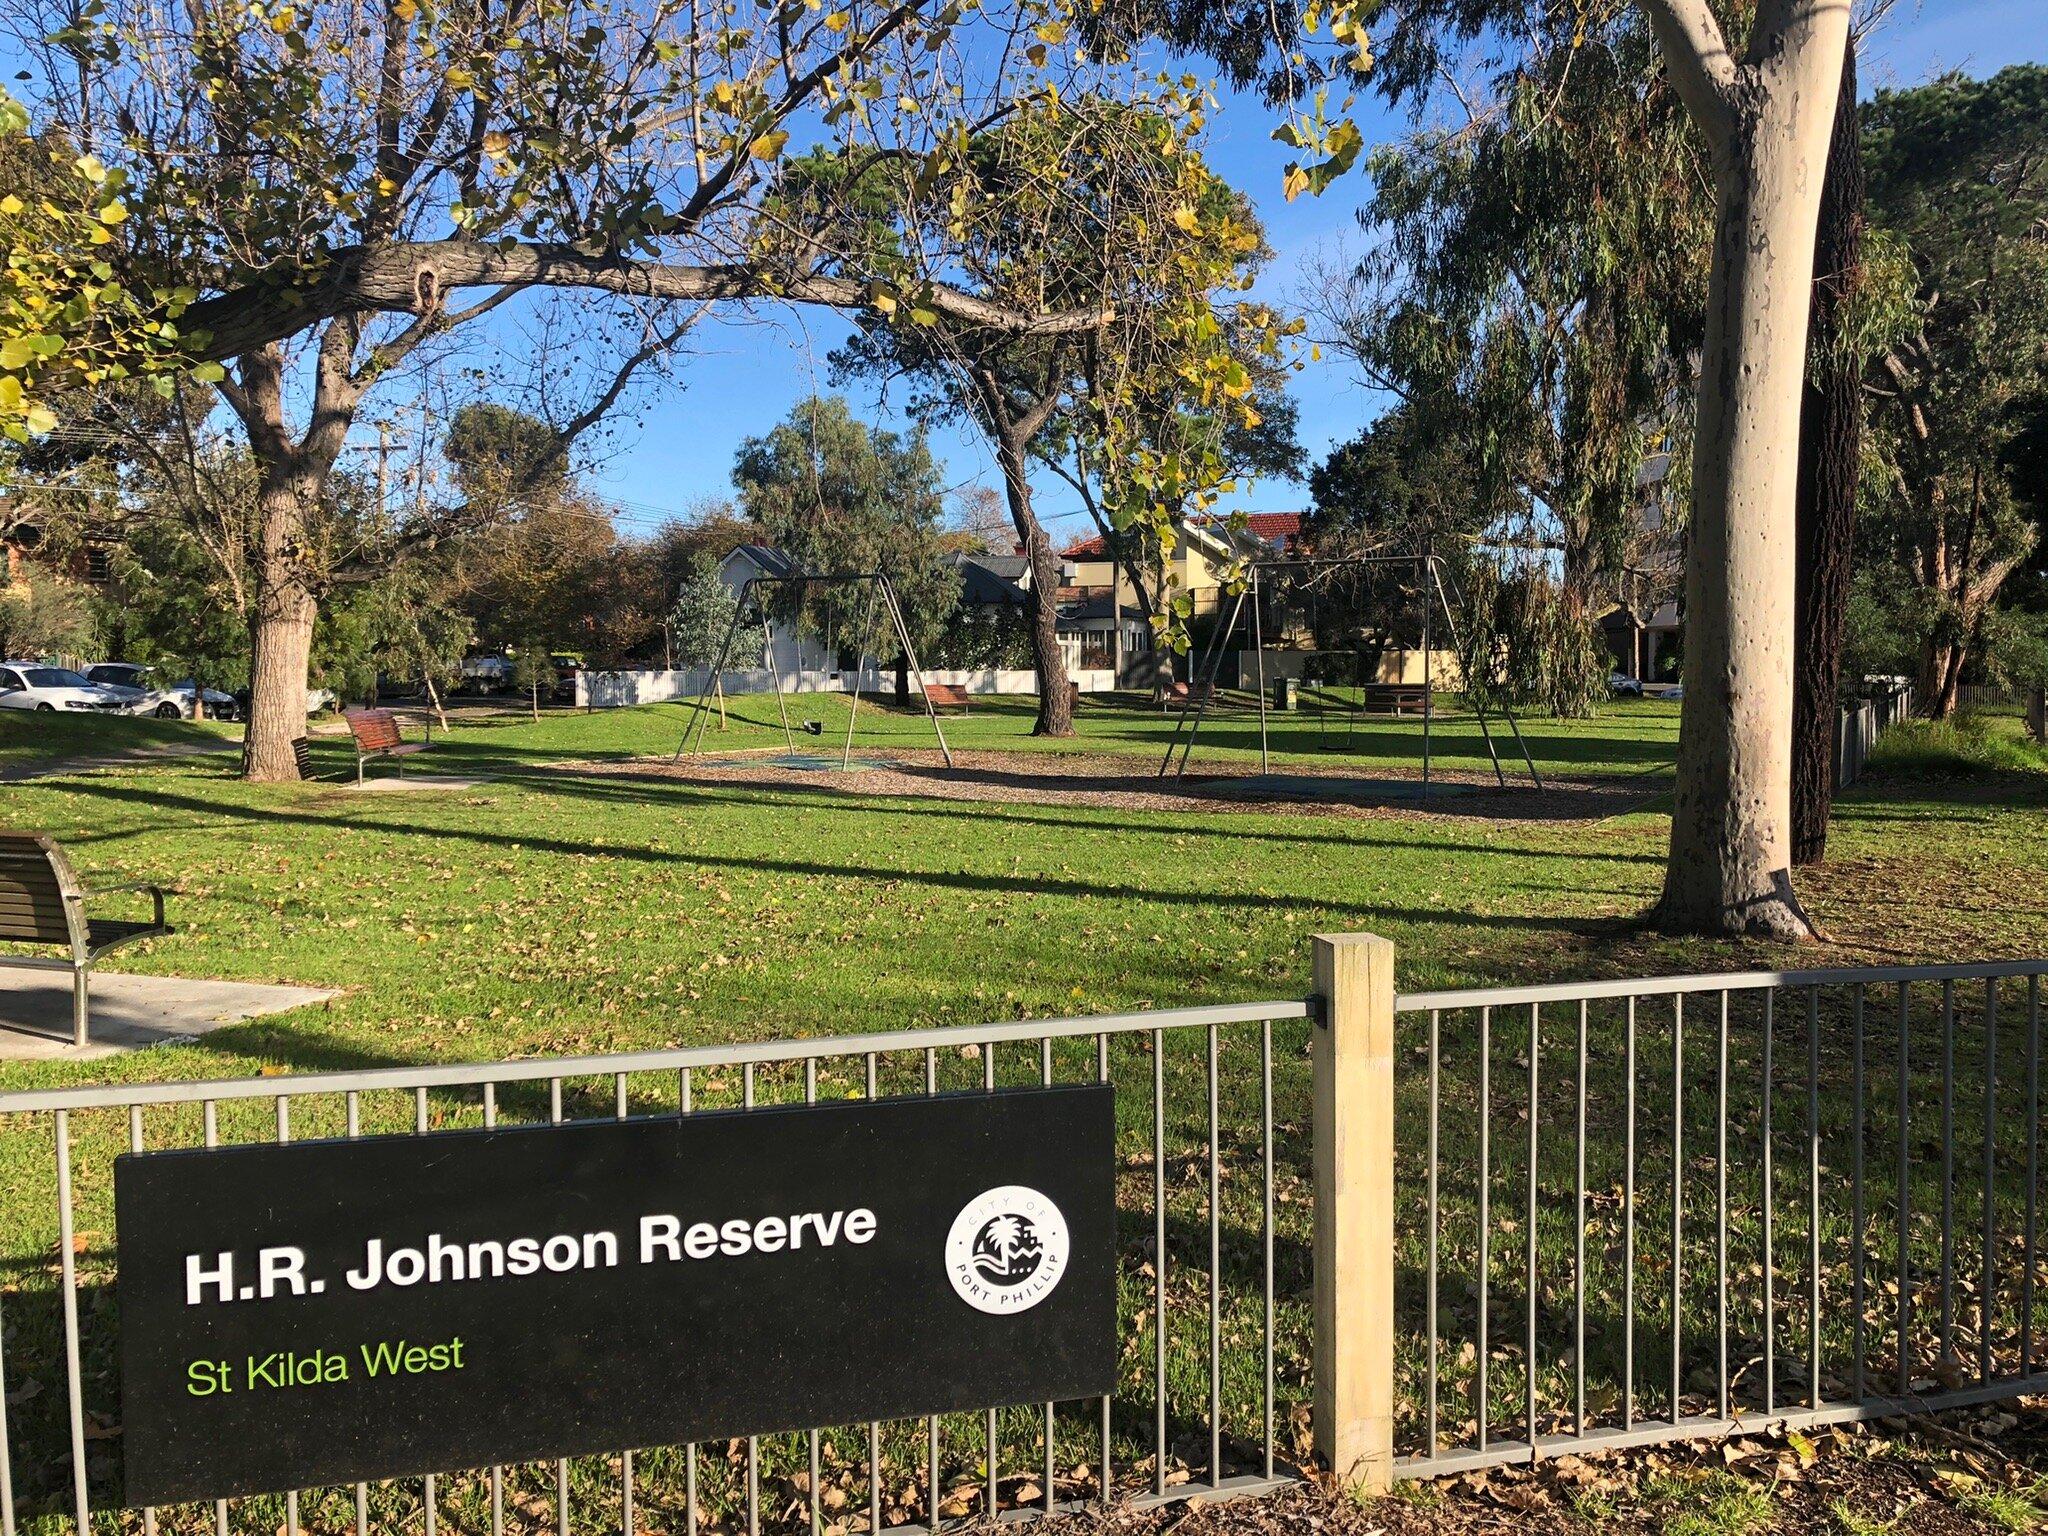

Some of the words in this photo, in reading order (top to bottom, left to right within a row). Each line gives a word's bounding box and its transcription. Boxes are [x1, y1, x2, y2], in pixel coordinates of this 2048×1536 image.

[968, 1196, 1010, 1226] CITY
[1026, 1201, 1046, 1218] OF
[186, 1247, 325, 1304] H.R.
[346, 1228, 617, 1289] Johnson
[640, 1208, 876, 1264] Reserve
[956, 1264, 991, 1301] PORT
[1000, 1254, 1058, 1305] PHILLIP
[187, 1360, 233, 1396] St
[247, 1350, 350, 1390] Kilda
[360, 1336, 465, 1378] West
